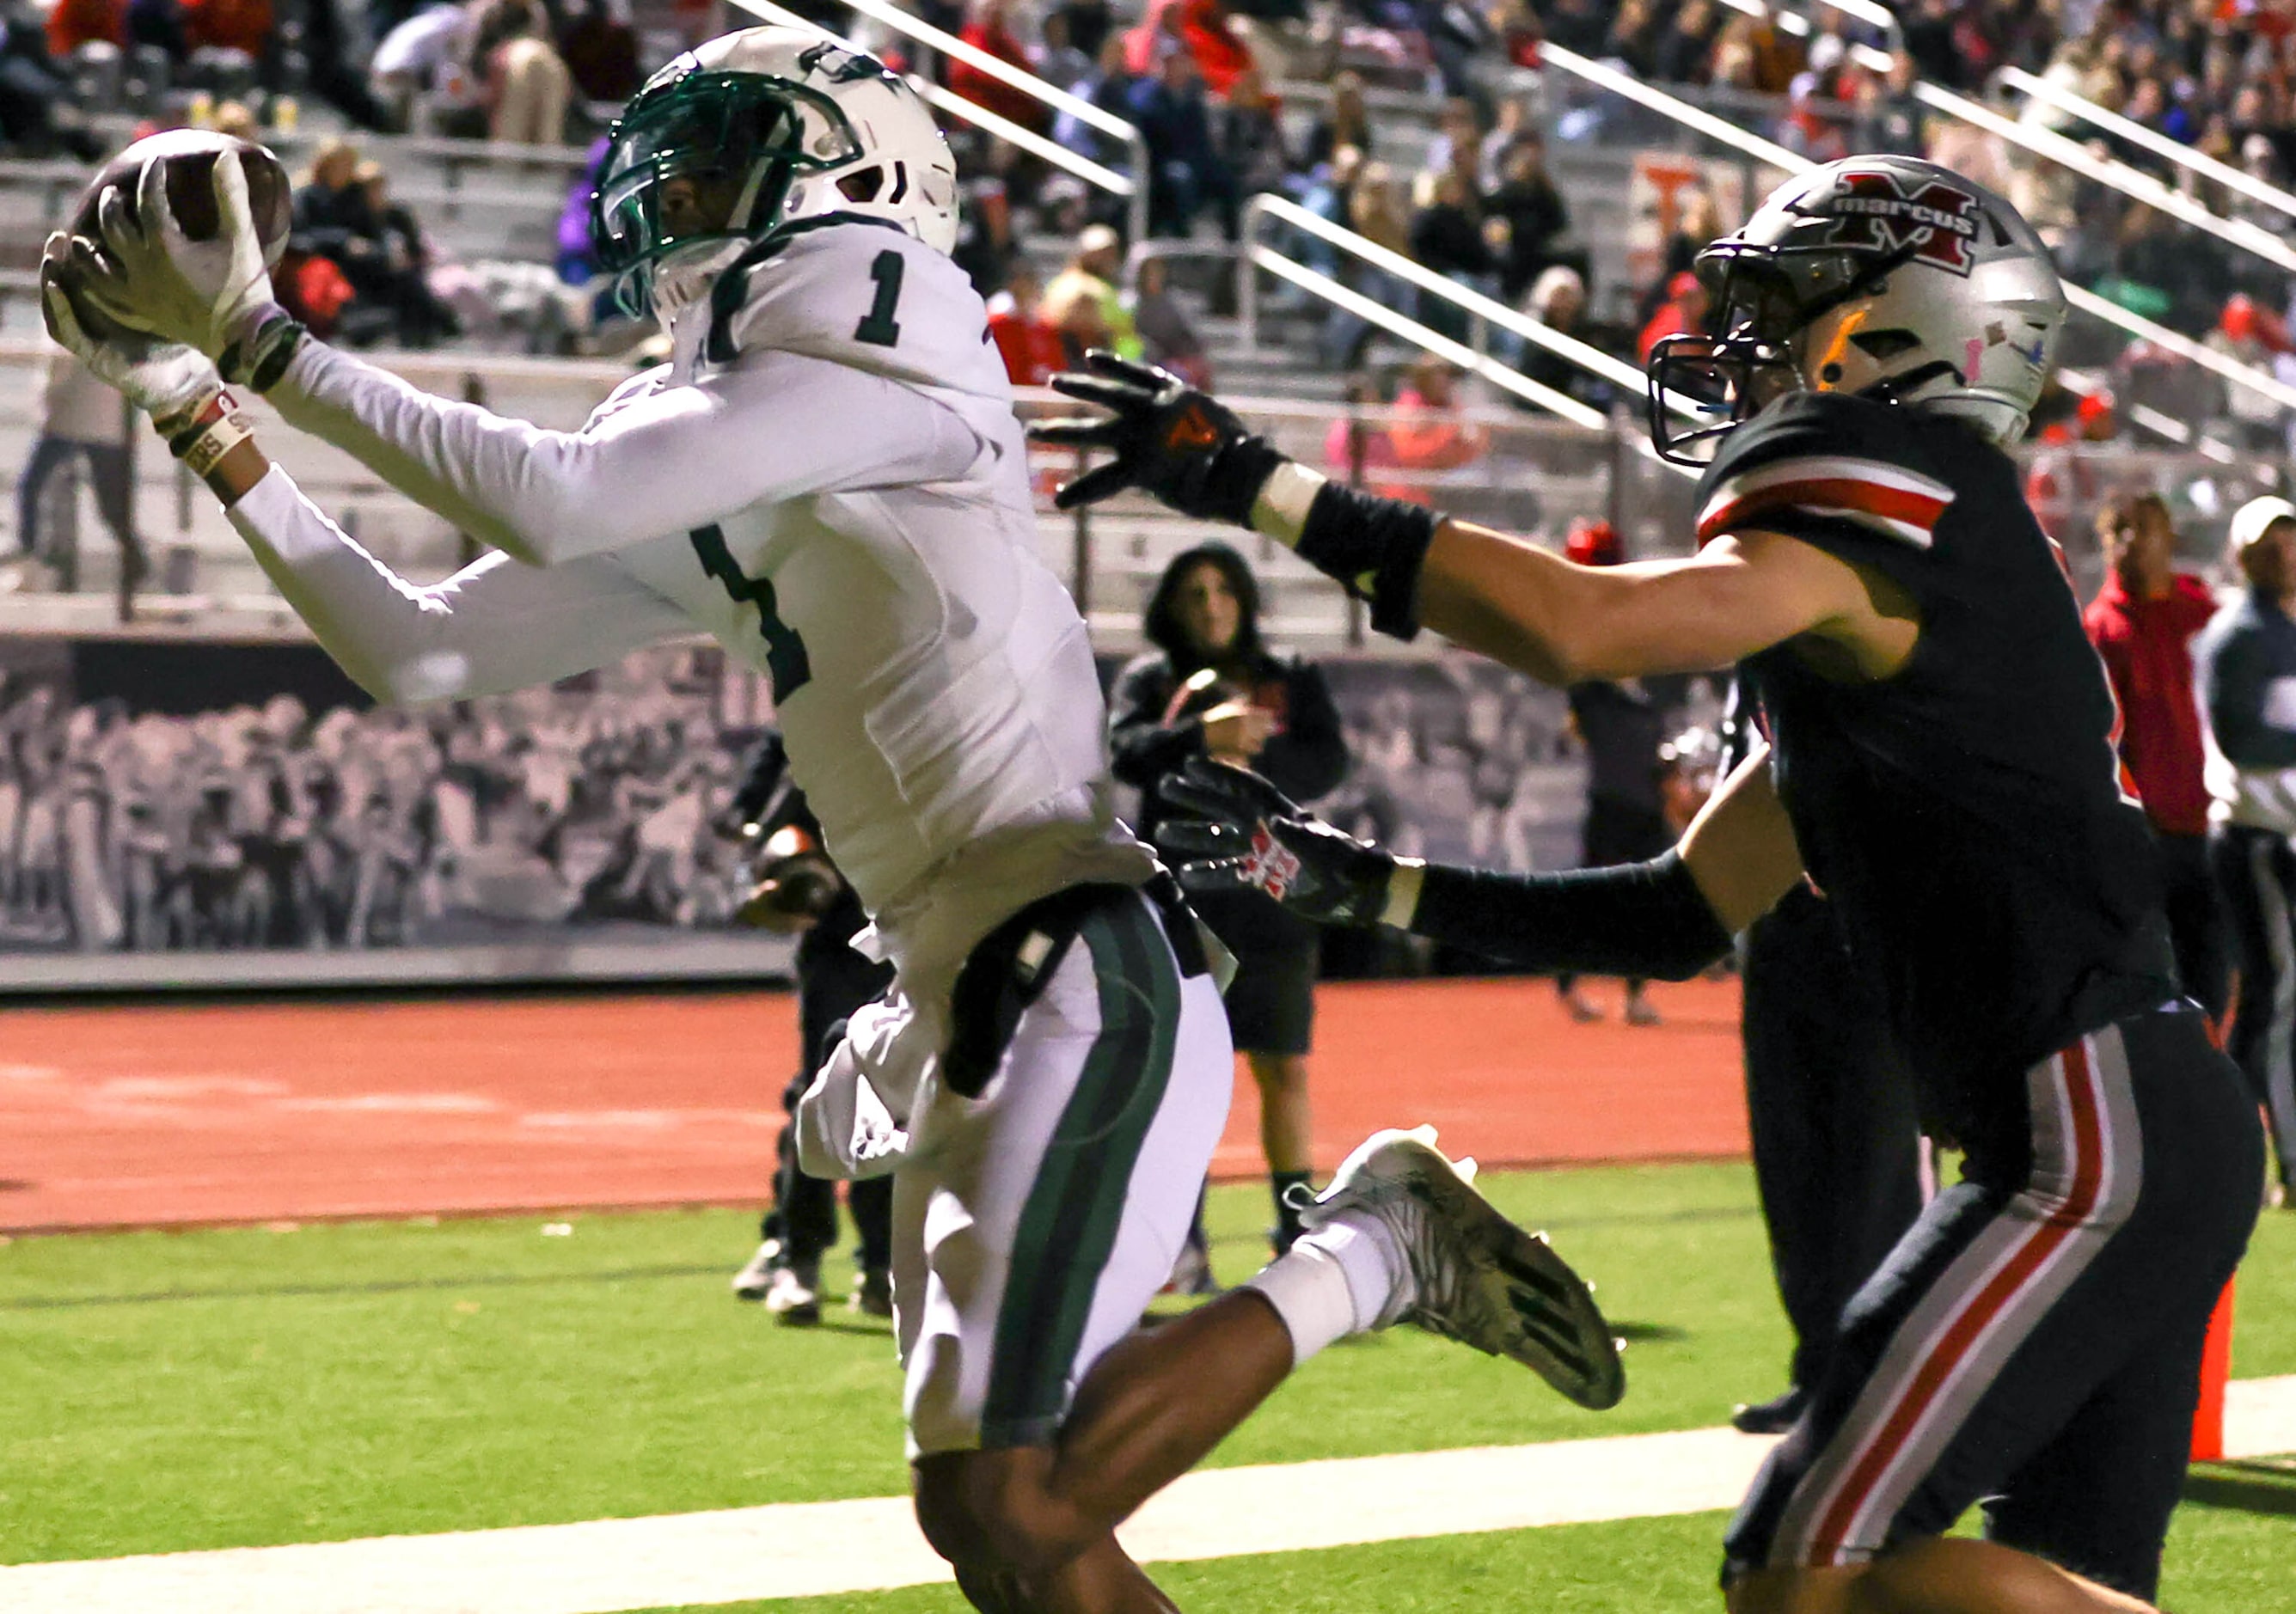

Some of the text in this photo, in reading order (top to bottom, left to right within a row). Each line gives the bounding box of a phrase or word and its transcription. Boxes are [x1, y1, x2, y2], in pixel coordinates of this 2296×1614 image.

[1833, 197, 1975, 236] marcus
[853, 248, 904, 348] 1
[689, 523, 812, 707] 1
